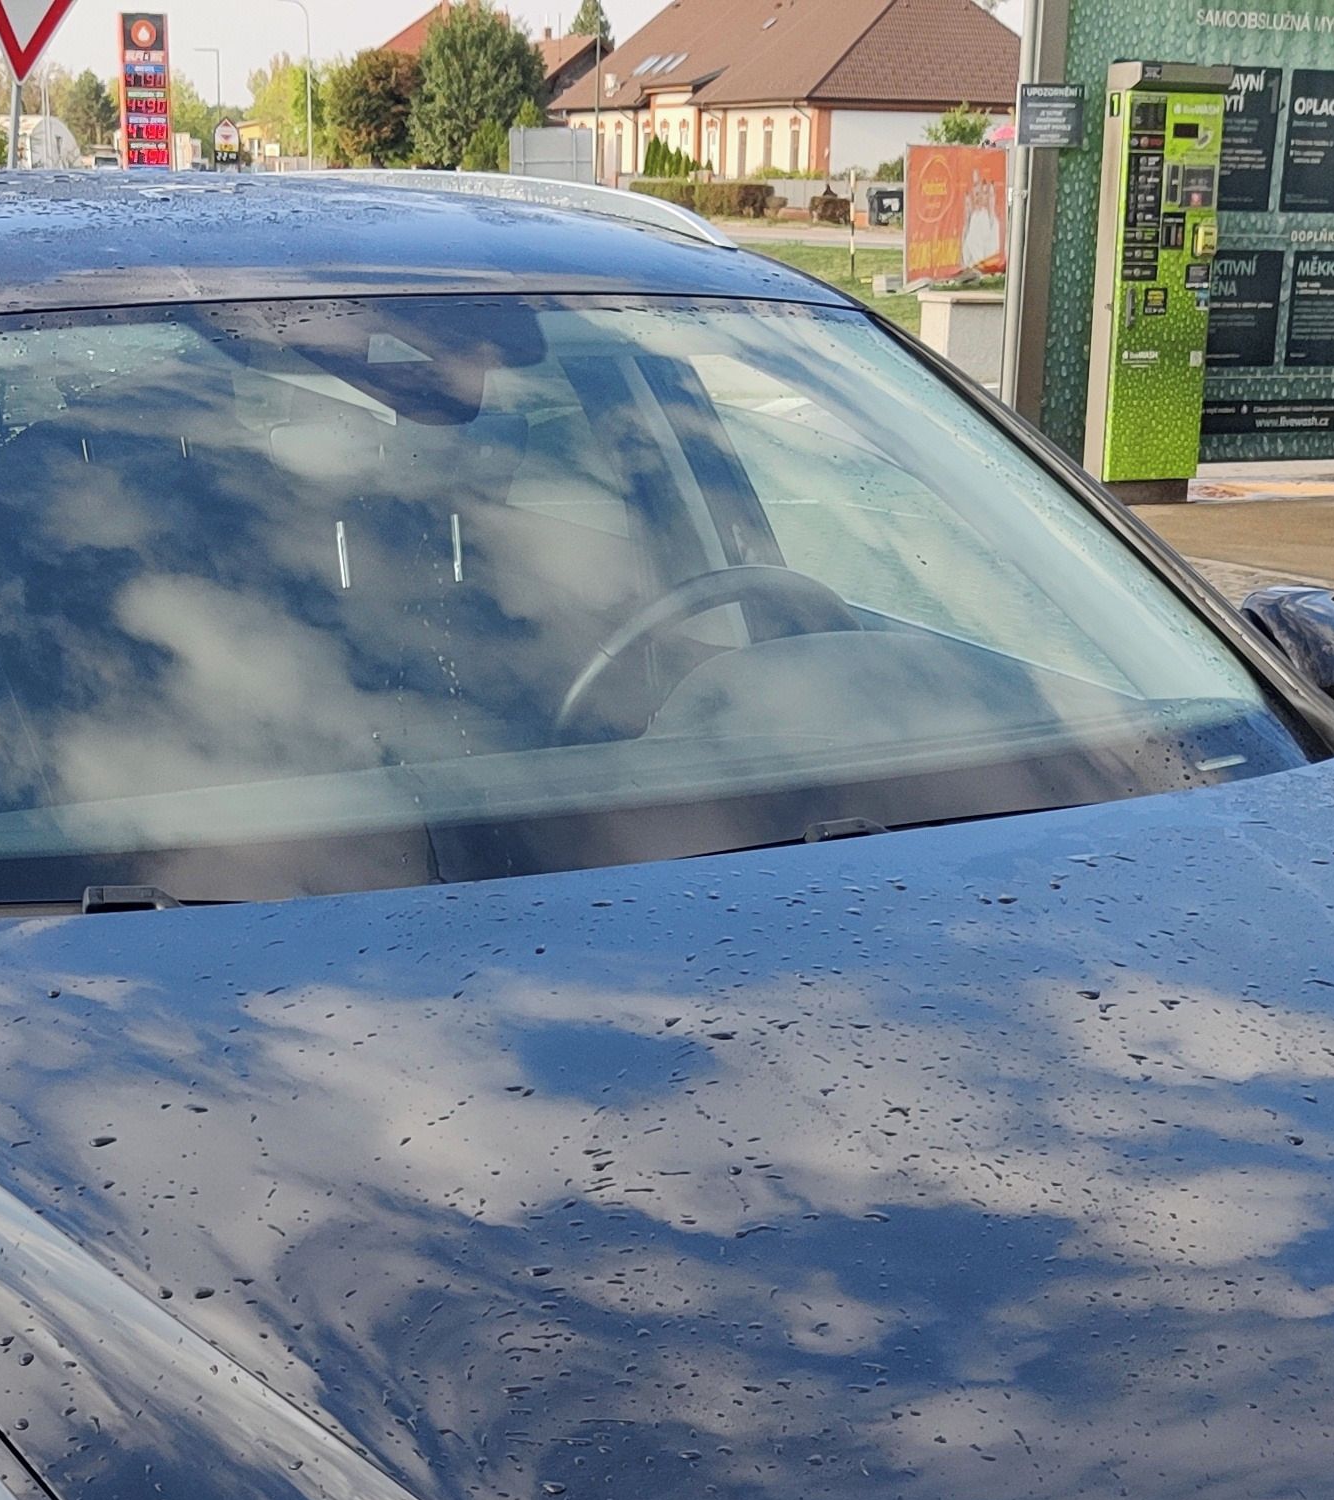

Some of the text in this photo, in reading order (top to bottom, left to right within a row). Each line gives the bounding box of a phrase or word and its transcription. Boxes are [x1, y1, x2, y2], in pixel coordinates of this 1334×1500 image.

[1196, 8, 1310, 32] SAMOOBSLUŽNÁ
[1228, 69, 1266, 92] AVNÍ
[1111, 94, 1120, 116] 1
[1224, 90, 1245, 112] YTÍ
[1213, 254, 1258, 276] KTIVNÍ
[1211, 276, 1237, 296] ĚNA
[1255, 415, 1329, 428] www.livewash.cz
